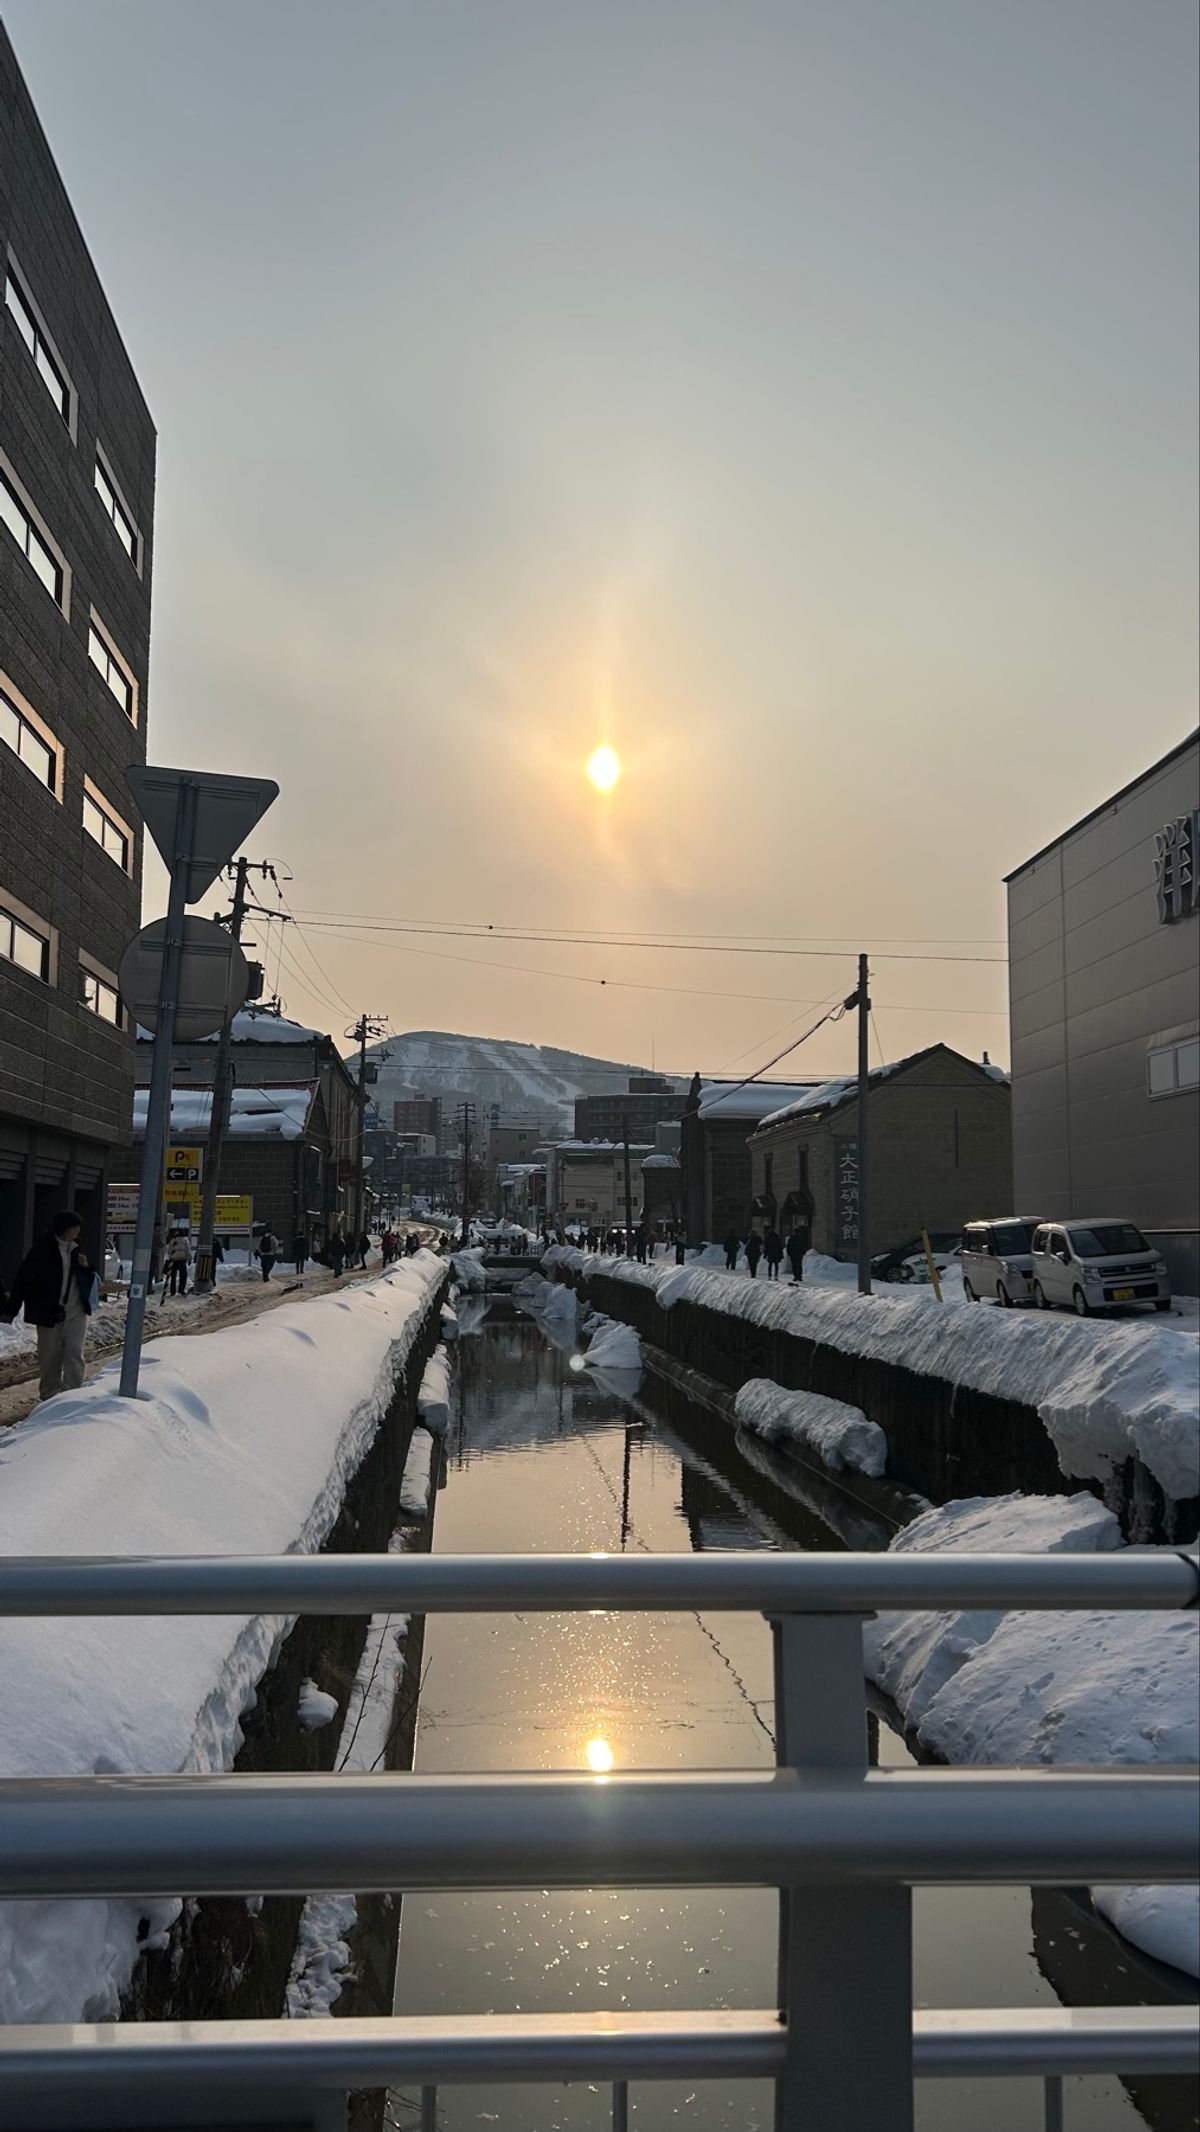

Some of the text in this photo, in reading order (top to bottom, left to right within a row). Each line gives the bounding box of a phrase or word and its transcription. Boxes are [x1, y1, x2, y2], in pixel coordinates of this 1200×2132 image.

[188, 1169, 196, 1179] P
[840, 1153, 859, 1239] 大正硝子館
